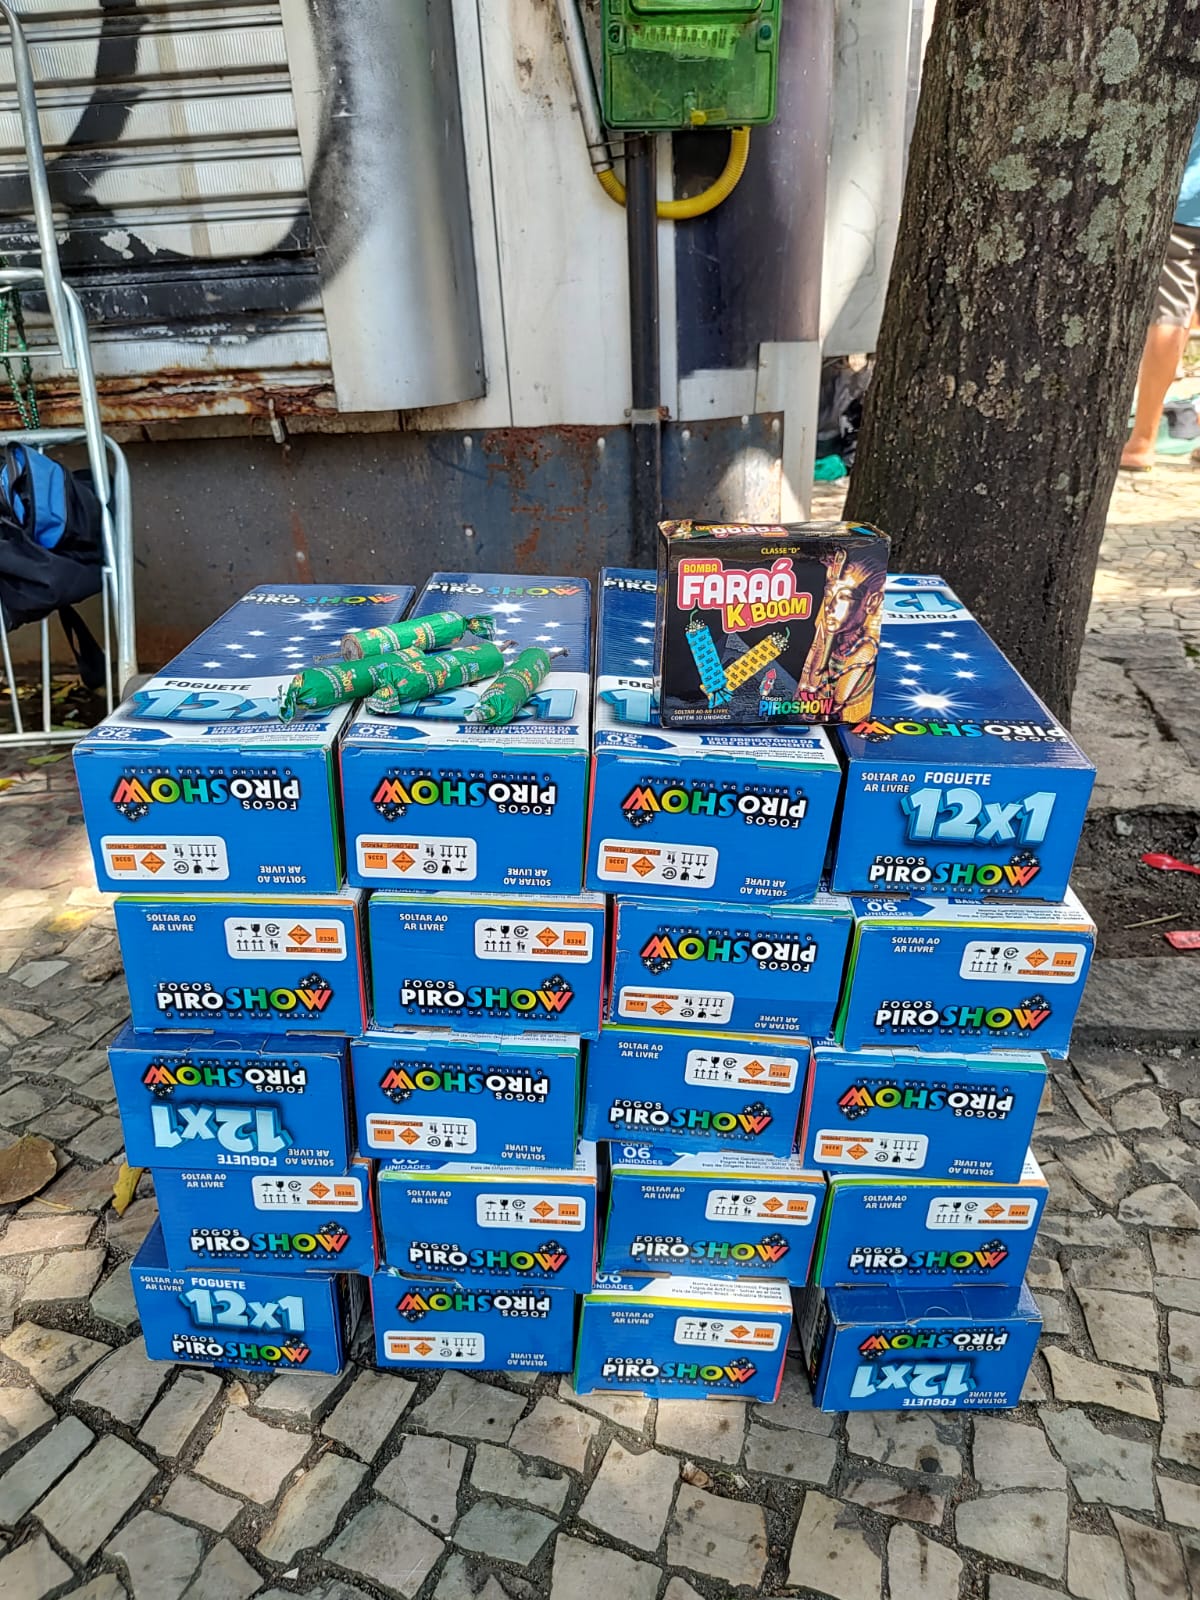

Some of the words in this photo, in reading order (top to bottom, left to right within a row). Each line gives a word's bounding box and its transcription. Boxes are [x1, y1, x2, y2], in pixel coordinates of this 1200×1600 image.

[684, 564, 717, 573] BOMBA
[427, 583, 582, 596] PIROSHOW
[683, 563, 792, 605] FARAÓ
[726, 604, 746, 629] K
[752, 597, 807, 622] BOOM
[165, 680, 252, 691] FOGUETE
[759, 699, 832, 716] PIROSHOW
[358, 727, 389, 736] 06
[852, 721, 1067, 737] PIROSHOW
[861, 773, 898, 782] SOLTAR
[901, 774, 915, 782] AO
[924, 772, 991, 786] FOGUETE
[113, 778, 300, 804] PIROSHOW
[373, 779, 556, 806] PIROSHOW
[864, 784, 878, 792] AR
[881, 784, 909, 793] LIVRE
[243, 801, 297, 810] FOGOS
[622, 787, 807, 818] PIROSHOW
[499, 805, 552, 815] FOGOS
[746, 816, 799, 828] FOGOS
[905, 788, 1056, 845] 12x1
[875, 856, 925, 866] FOGOS
[272, 875, 306, 884] SOLTAR
[869, 863, 1040, 887] PIROSHOW
[520, 878, 551, 886] SOLTAR
[745, 878, 770, 886] LIVRE
[754, 888, 787, 896] SOLTAR
[867, 902, 898, 912] 06
[146, 914, 179, 922] SOLTAR
[400, 914, 432, 922] SOLTAR
[420, 923, 444, 931] LIVRE
[892, 936, 924, 944] SOLTAR
[641, 936, 816, 962] PIROSHOW
[760, 962, 809, 972] FOGOS
[159, 983, 212, 991] FOGOS
[404, 980, 455, 988] FOGOS
[157, 988, 332, 1010] PIROSHOW
[401, 988, 573, 1012] PIROSHOW
[882, 1001, 932, 1009] FOGOS
[875, 1006, 1051, 1029] PIROSHOW
[618, 1042, 649, 1050] SOLTAR
[144, 1066, 306, 1086] PIROSHOW
[381, 1069, 548, 1094] PIROSHOW
[256, 1085, 304, 1093] FOGOS
[496, 1092, 545, 1102] FOGOS
[839, 1086, 1013, 1111] PIROSHOW
[614, 1100, 662, 1109] FOGOS
[955, 1109, 1006, 1119] FOGOS
[610, 1108, 771, 1134] PIROSHOW
[152, 1105, 291, 1153] 12x1
[516, 1152, 545, 1160] SOLTAR
[623, 1147, 650, 1158] 06
[217, 1154, 277, 1166] FOGUETE
[302, 1158, 334, 1166] SOLTAR
[964, 1168, 994, 1176] SOLTAR
[190, 1234, 349, 1252] PIROSHOW
[636, 1235, 682, 1243] FOGOS
[412, 1242, 458, 1250] FOGOS
[631, 1241, 788, 1262] PIROSHOW
[409, 1249, 568, 1271] PIROSHOW
[850, 1252, 1007, 1269] PIROSHOW
[192, 1278, 246, 1289] FOGUETE
[398, 1293, 549, 1312] PIROSHOW
[182, 1289, 304, 1333] 12x1
[174, 1334, 214, 1343] FOGOS
[860, 1333, 1008, 1350] PIROSHOW
[173, 1341, 309, 1363] PIROSHOW
[602, 1363, 756, 1383] PIROSHOW
[850, 1364, 975, 1398] 12x1
[904, 1398, 956, 1406] FOGUETE
